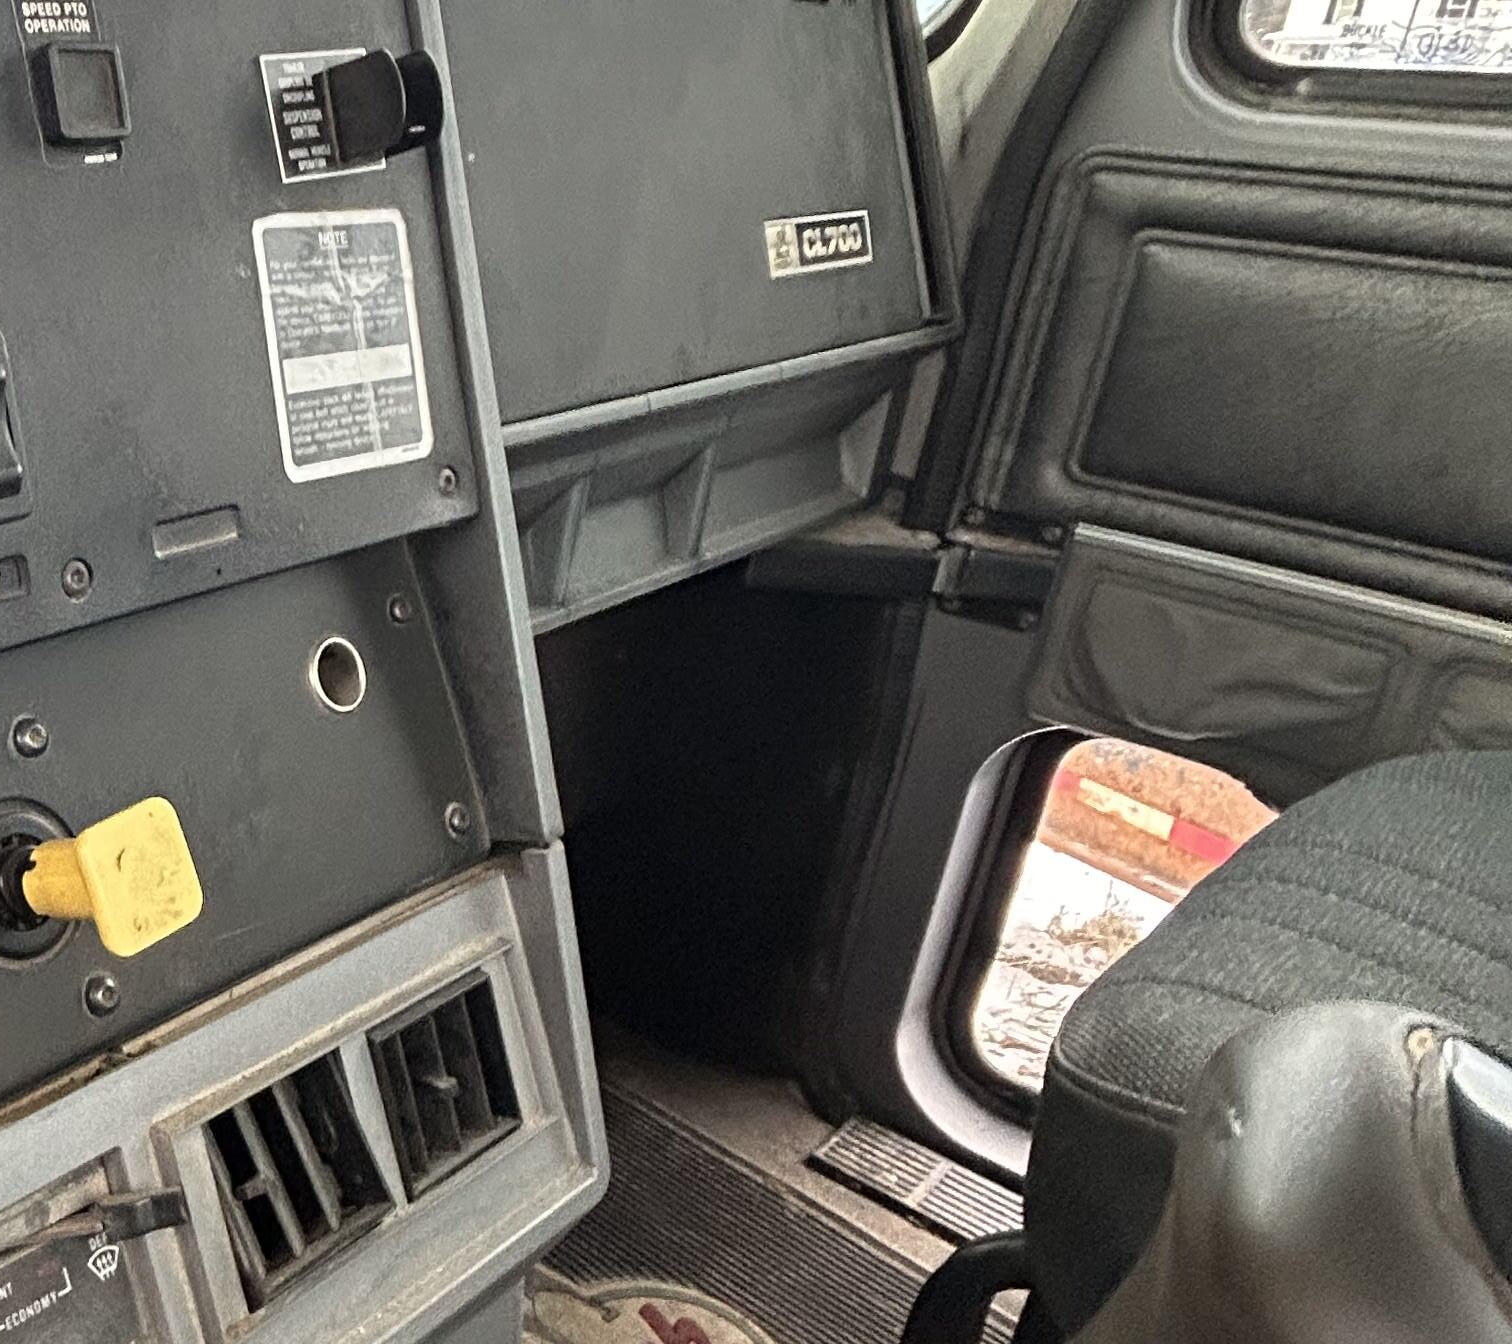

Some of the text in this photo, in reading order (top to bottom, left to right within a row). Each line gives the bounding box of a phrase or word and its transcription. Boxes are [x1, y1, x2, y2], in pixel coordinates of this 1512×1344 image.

[21, 2, 87, 17] SPEED PTO
[24, 18, 91, 34] OPERATION
[802, 222, 863, 258] CL700
[88, 1233, 108, 1252] DEF
[5, 1291, 58, 1331] ECONOMY
